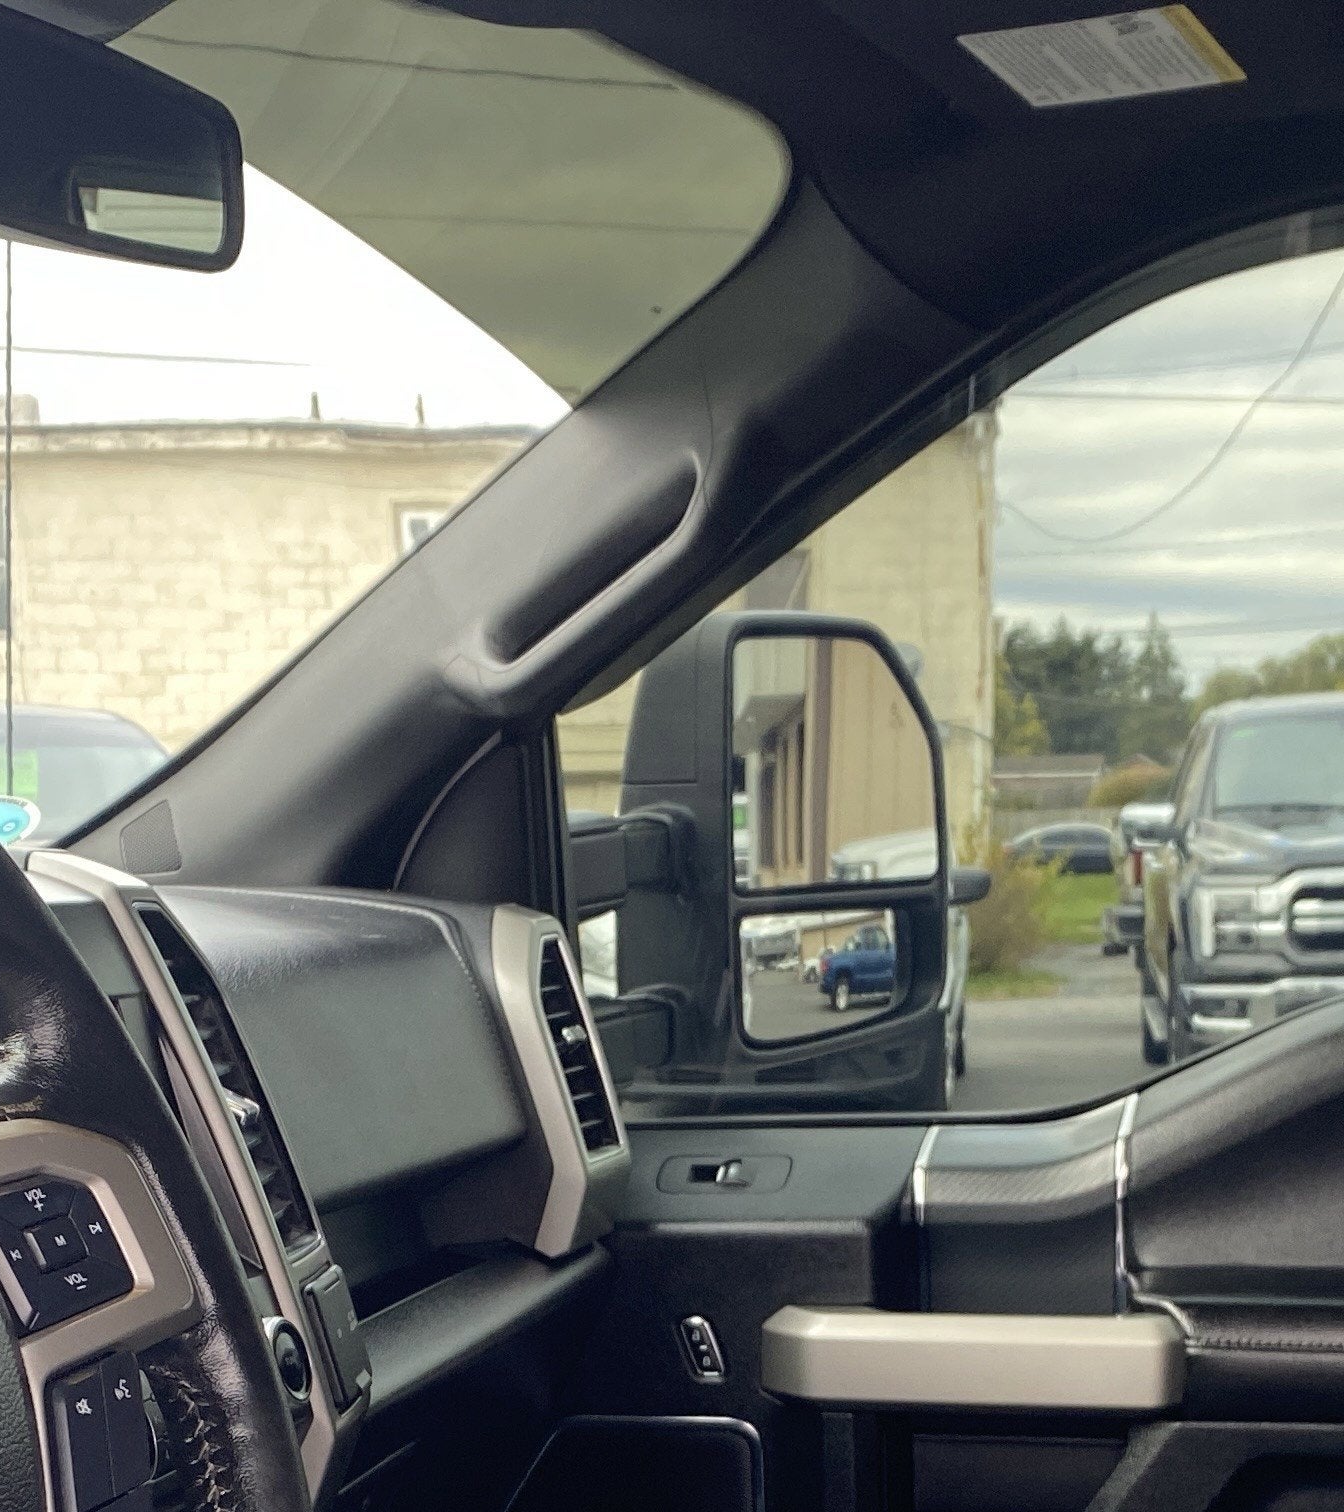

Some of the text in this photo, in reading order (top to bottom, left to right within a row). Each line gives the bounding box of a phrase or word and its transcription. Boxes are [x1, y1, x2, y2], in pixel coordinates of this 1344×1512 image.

[23, 1187, 47, 1202] VOL
[54, 1234, 67, 1247] M
[63, 1272, 88, 1285] VOL
